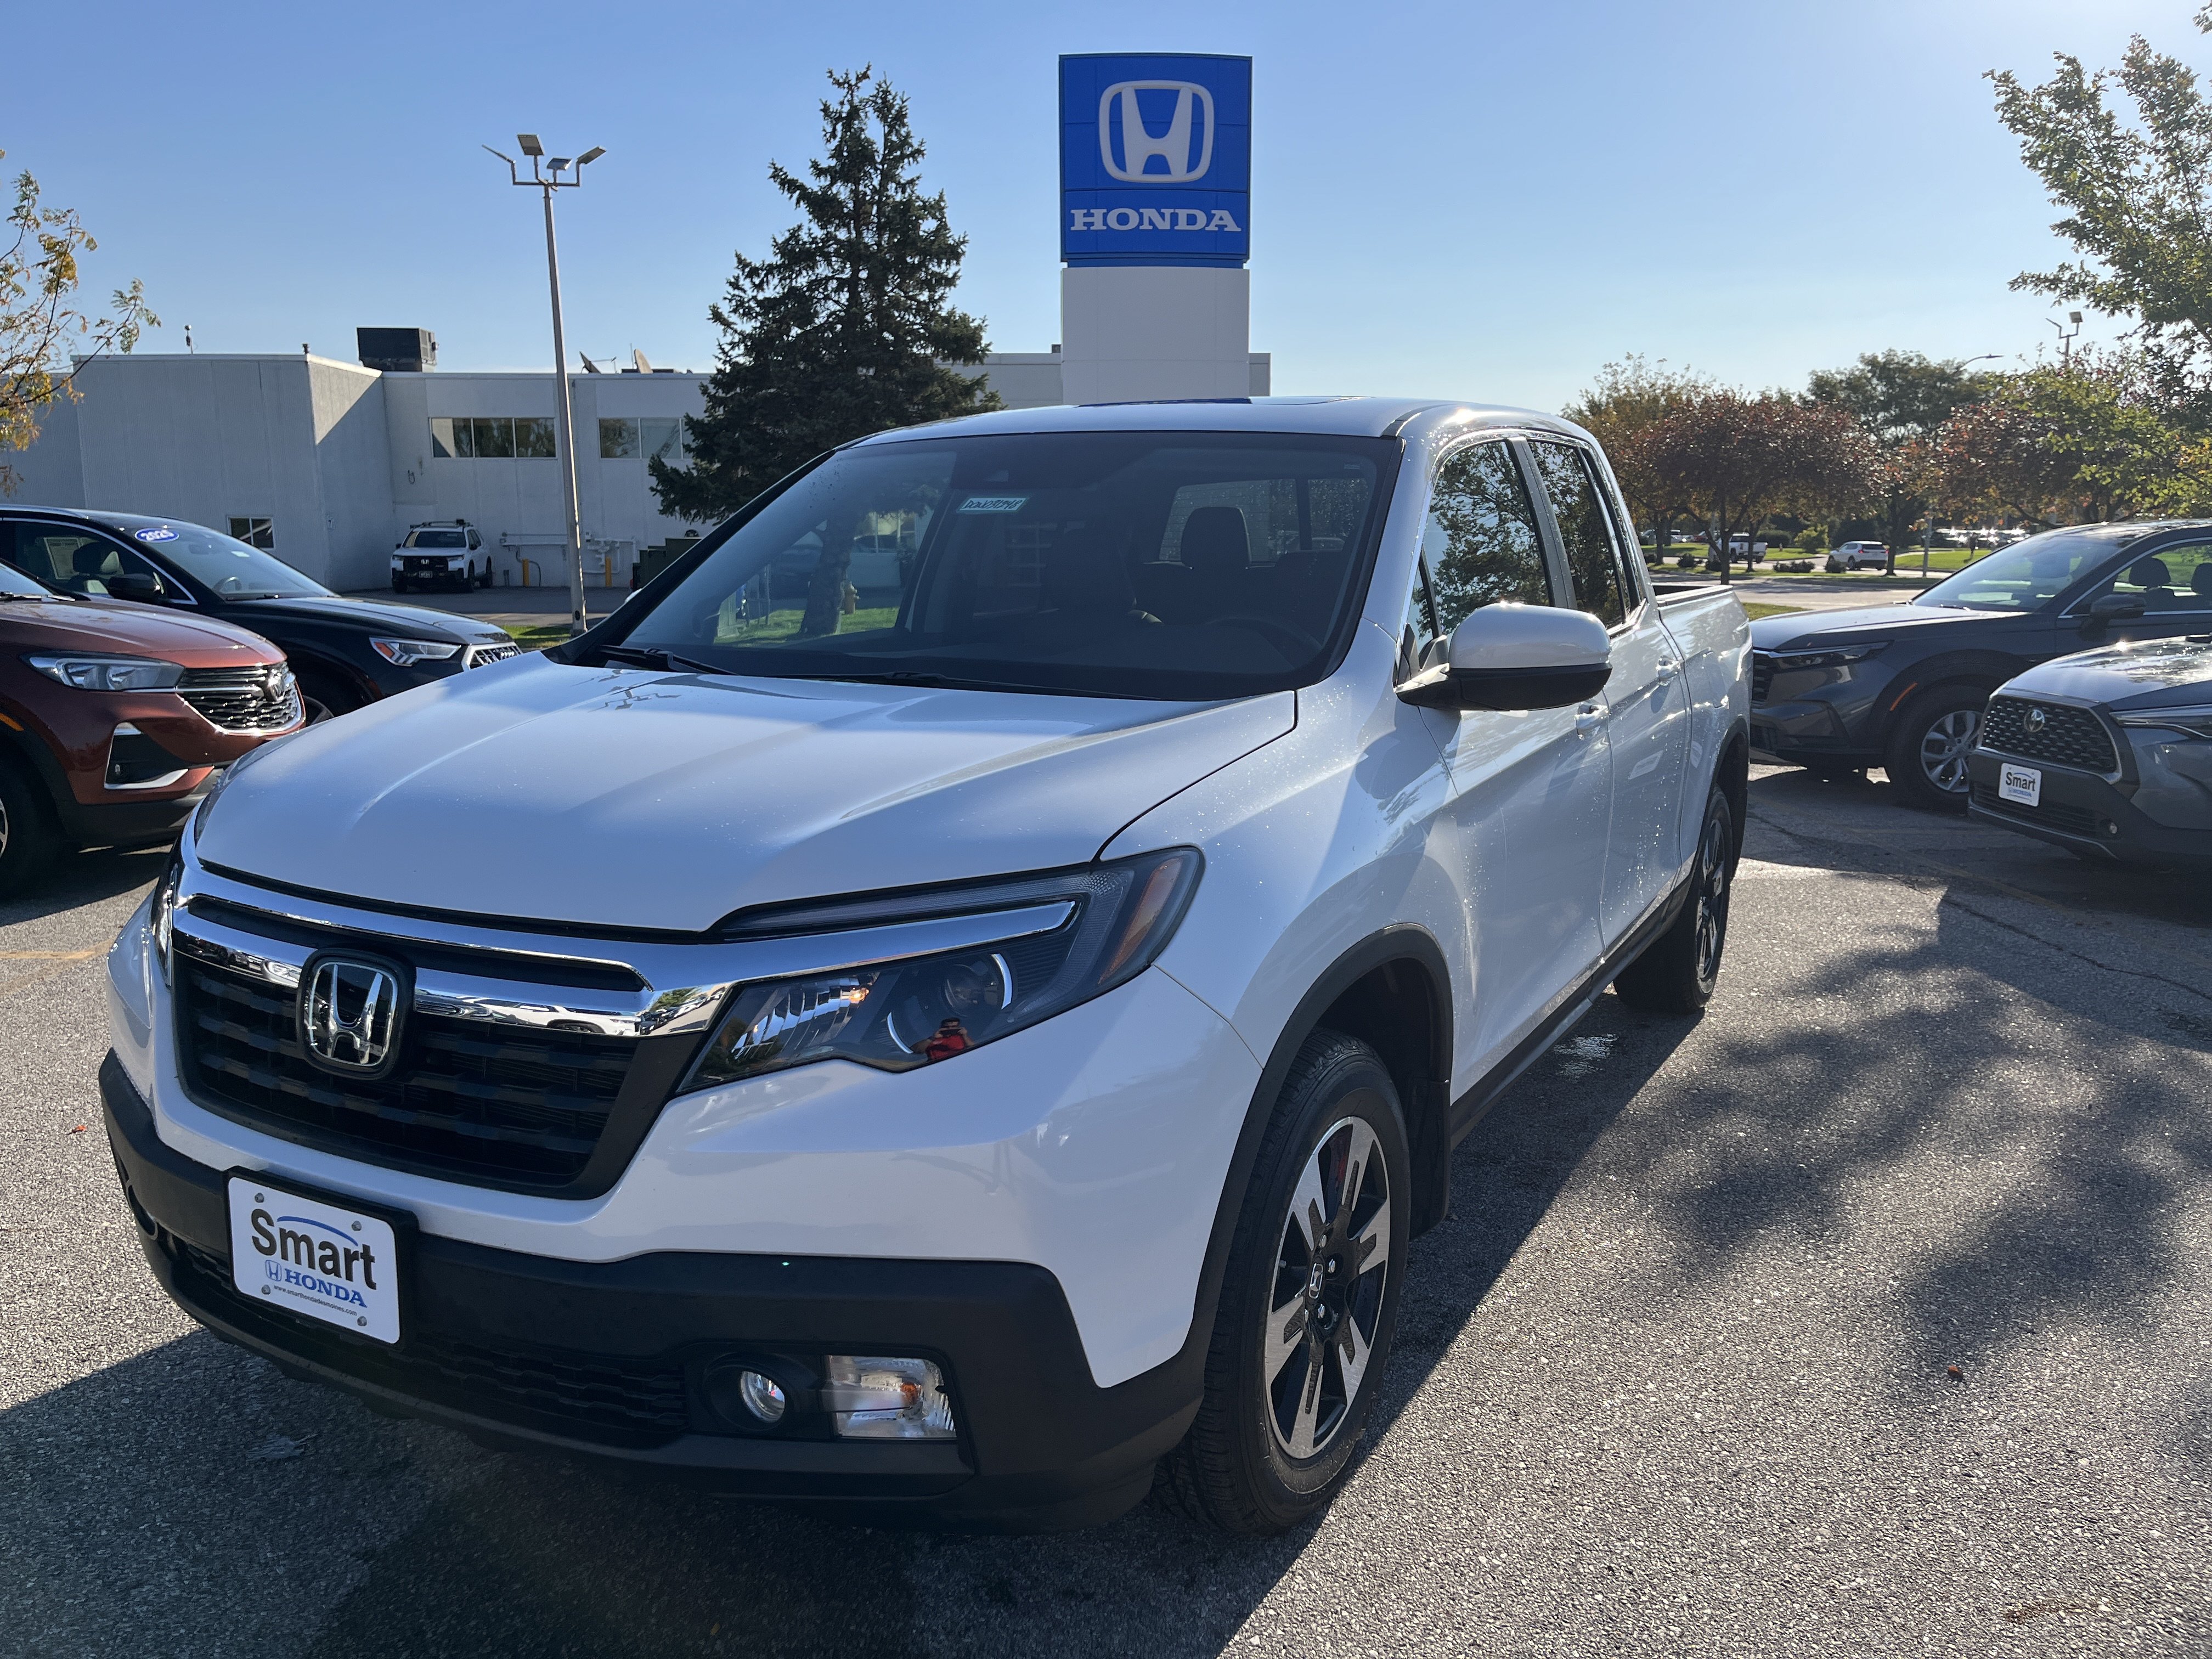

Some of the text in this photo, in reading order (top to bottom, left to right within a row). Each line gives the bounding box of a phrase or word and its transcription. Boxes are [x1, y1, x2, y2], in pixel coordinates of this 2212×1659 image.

[1070, 208, 1242, 232] HONDA
[2005, 771, 2036, 792] Smart
[251, 1208, 377, 1290] Smart
[284, 1268, 368, 1308] HONDA
